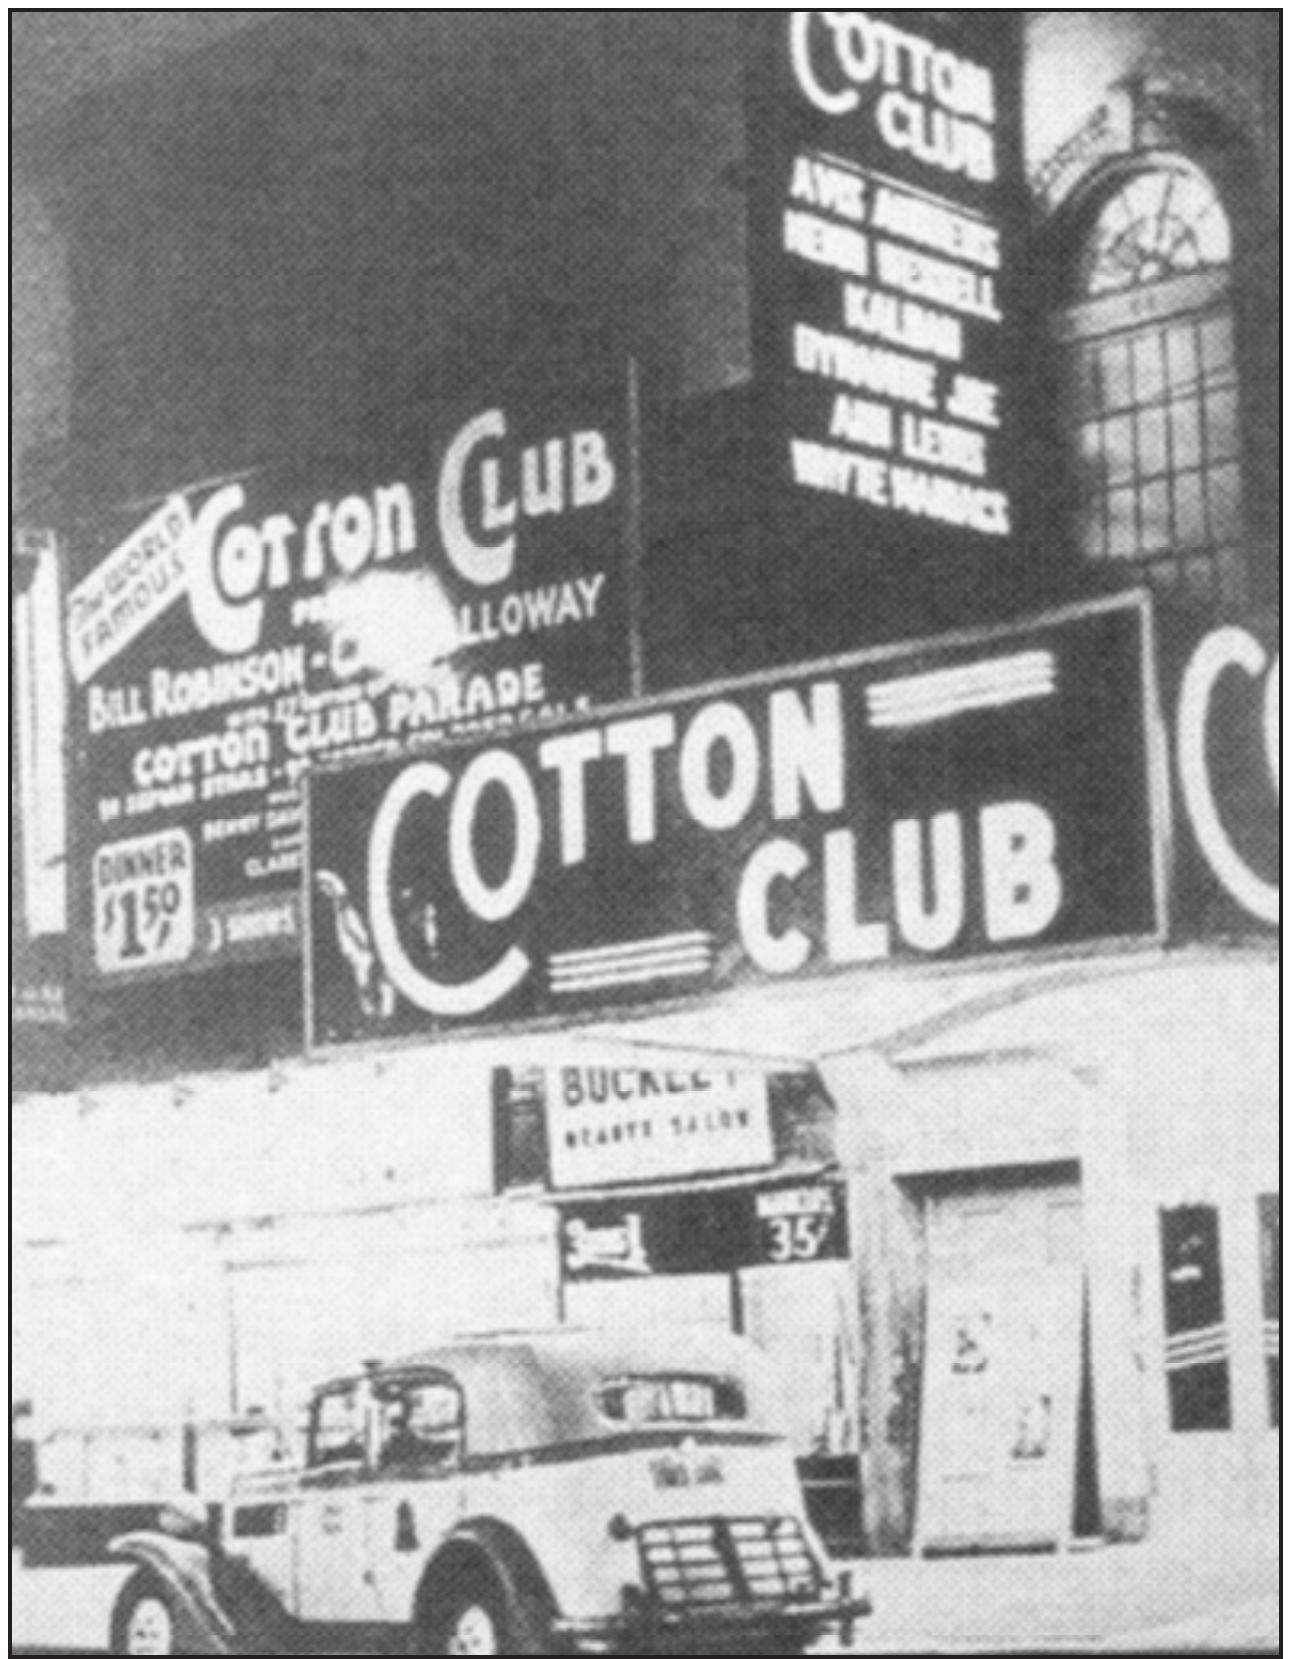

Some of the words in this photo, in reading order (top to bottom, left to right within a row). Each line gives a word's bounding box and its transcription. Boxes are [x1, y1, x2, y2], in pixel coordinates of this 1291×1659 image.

[876, 89, 997, 183] CLUB
[437, 408, 615, 586] CLUB
[80, 549, 186, 658] FAMOUS
[89, 684, 149, 734] BILL
[152, 643, 306, 719] ROBINSON
[285, 700, 379, 753] CLUB
[388, 660, 546, 734] PARADE
[99, 839, 187, 888] DINNER
[367, 680, 845, 1015] COTTON
[737, 800, 1063, 974] CLUB
[670, 1108, 749, 1137] SALON
